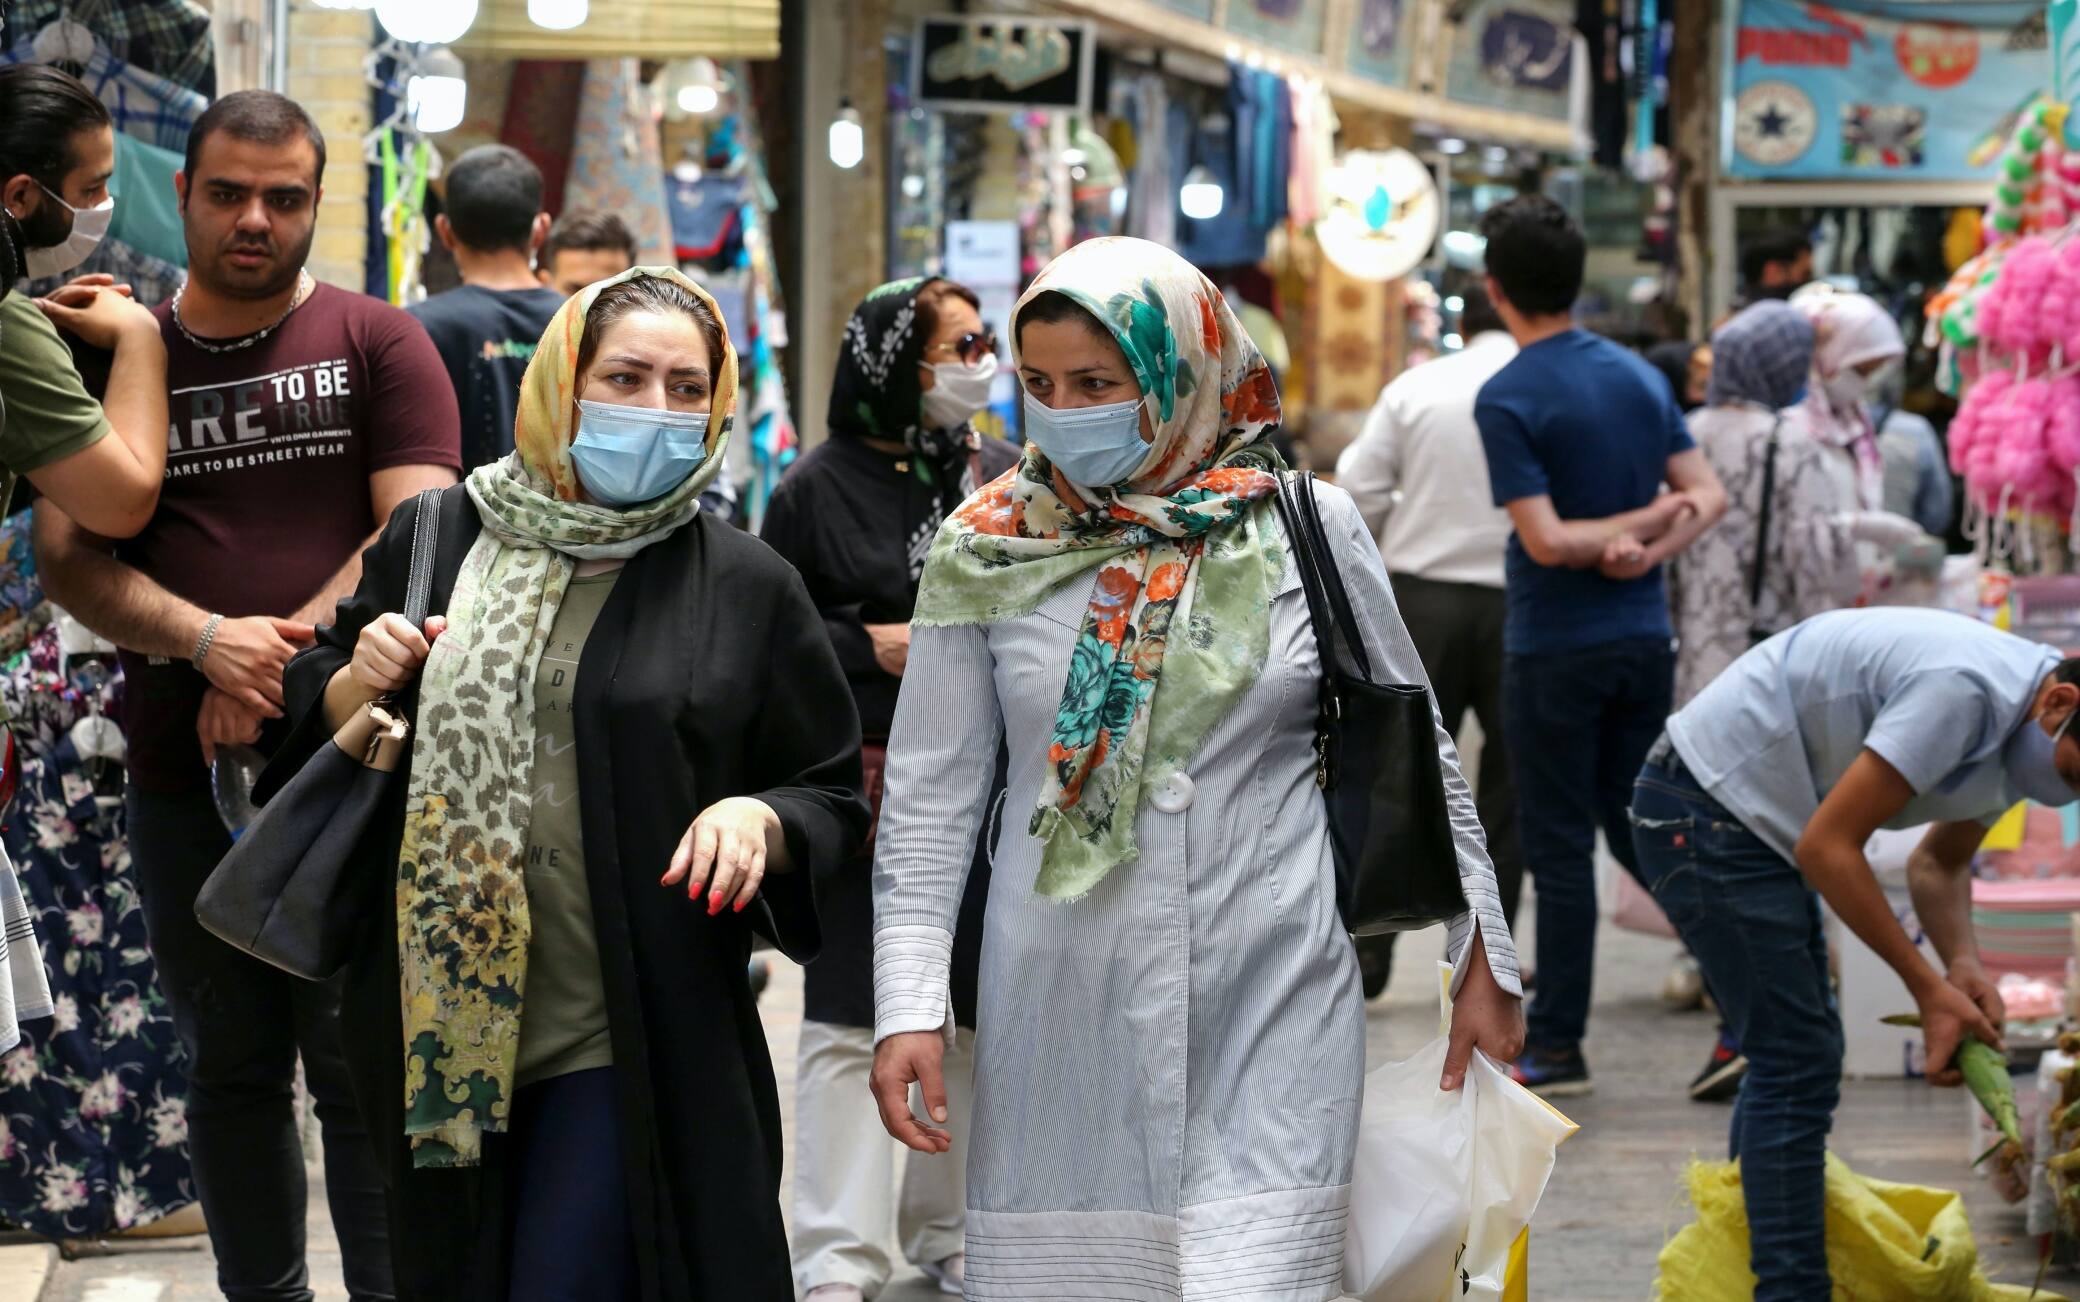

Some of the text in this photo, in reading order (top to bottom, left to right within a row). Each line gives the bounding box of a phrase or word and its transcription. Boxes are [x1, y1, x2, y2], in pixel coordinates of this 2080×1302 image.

[271, 372, 306, 403] TO
[314, 366, 351, 397] BE
[168, 382, 267, 452] RE
[275, 398, 351, 432] TRUE
[312, 429, 352, 438] GARMENTS
[204, 460, 222, 472] TO
[226, 456, 244, 469] BE
[248, 447, 302, 466] STREET
[305, 443, 345, 457] WEAR
